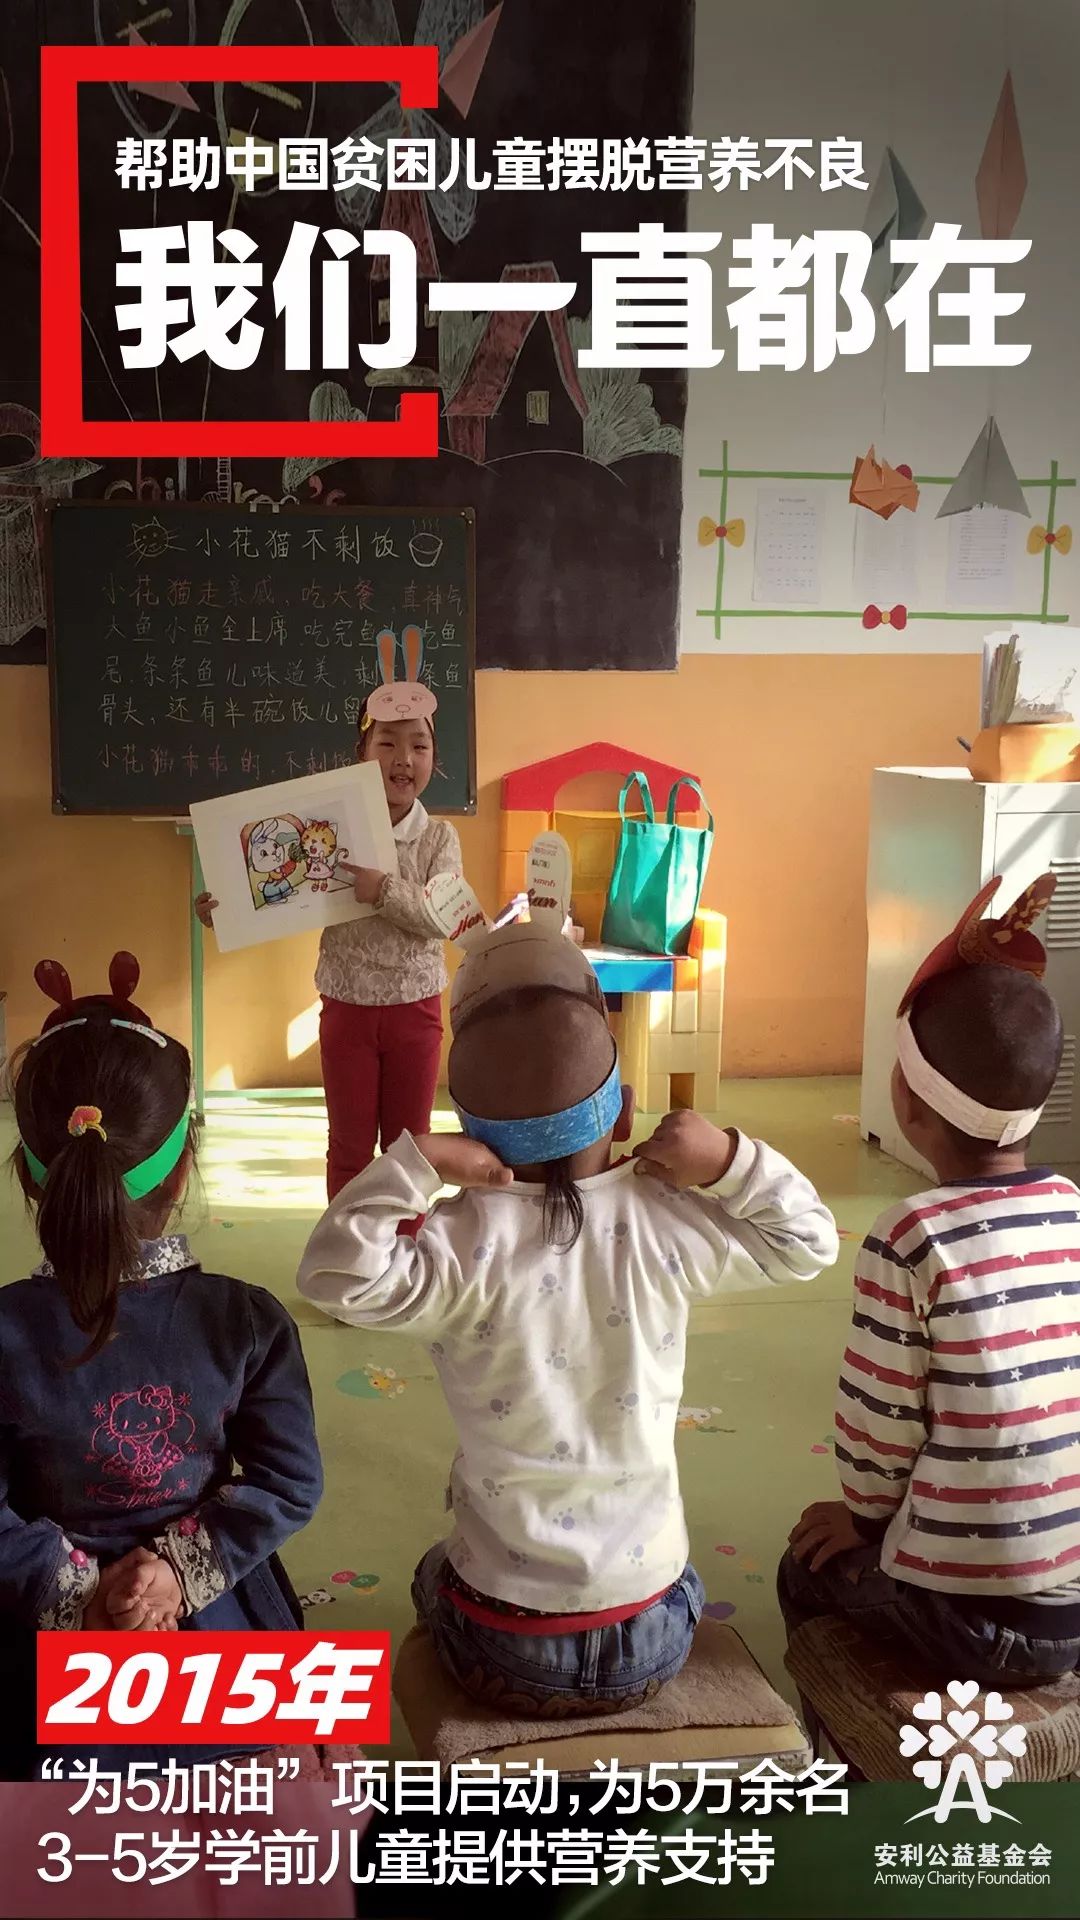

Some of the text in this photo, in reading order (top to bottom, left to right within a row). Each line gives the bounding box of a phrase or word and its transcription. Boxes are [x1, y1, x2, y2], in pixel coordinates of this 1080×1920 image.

[195, 524, 400, 566] 小花猫不剩饭
